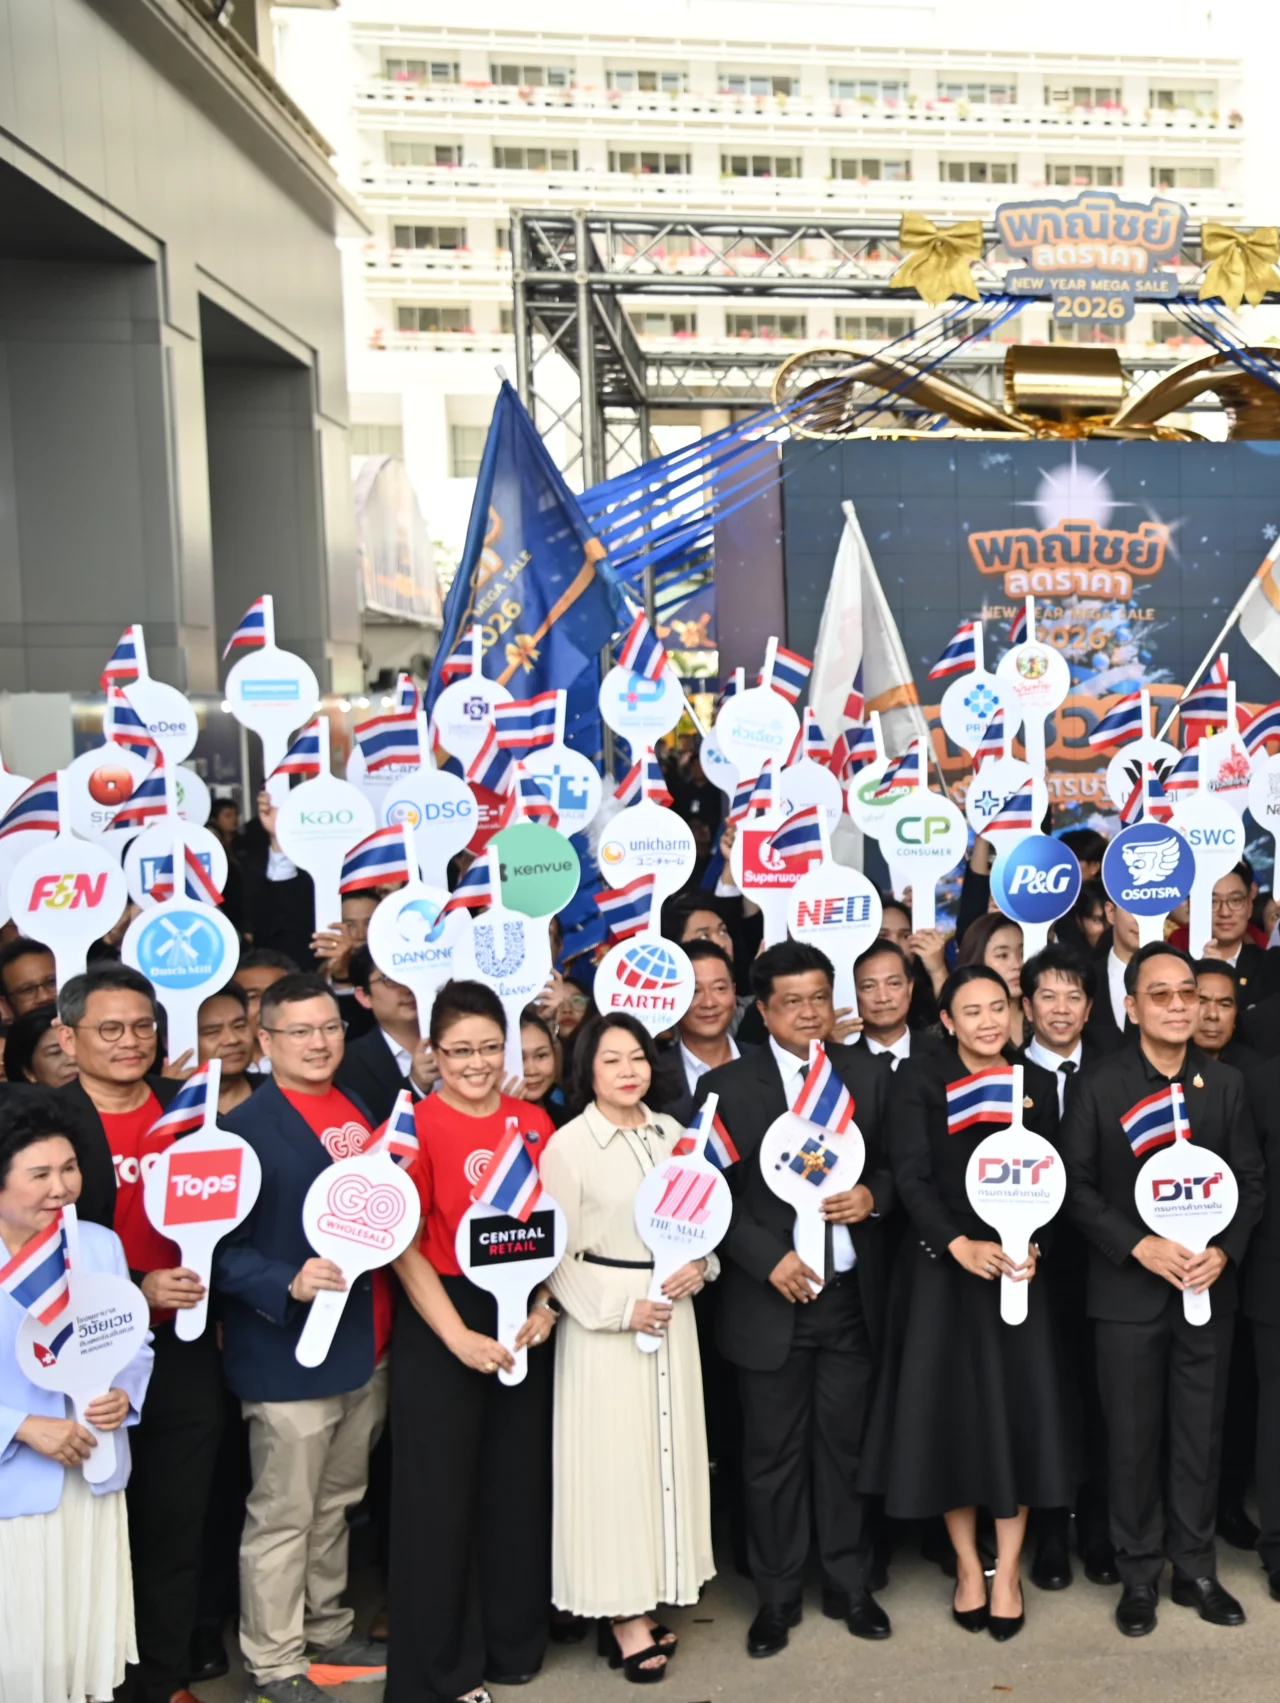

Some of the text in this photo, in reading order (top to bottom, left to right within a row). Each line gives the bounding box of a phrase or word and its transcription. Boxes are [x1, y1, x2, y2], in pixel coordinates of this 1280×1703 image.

[1004, 202, 1180, 250] พาณิชย์
[1033, 243, 1148, 271] ลดราคา
[1012, 277, 1169, 293] NEW YEAR MEGA SALE
[1056, 295, 1125, 319] 2026
[971, 521, 1166, 574] พาณิชย์
[503, 550, 532, 581] SALE
[1006, 570, 1131, 596] ลดราคา
[982, 605, 1016, 619] NEW
[1033, 607, 1063, 620] EAR
[480, 598, 522, 656] 026
[146, 721, 187, 732] eDee
[426, 800, 472, 820] DSG
[896, 816, 951, 844] CP
[1189, 829, 1237, 846] SWC
[630, 838, 690, 851] unicharm
[897, 848, 952, 857] CONSUMER
[1009, 863, 1073, 895] P&G
[28, 872, 108, 912] F&N
[1121, 887, 1181, 901] OSOTSPA
[797, 895, 872, 926] NEO
[151, 964, 213, 977] Dutch Mill
[611, 992, 676, 1010] EARTH
[171, 1174, 237, 1200] Tops
[327, 1174, 406, 1232] GO
[325, 1219, 389, 1244] WHOLESALE
[479, 1227, 545, 1246] CENTRAL
[650, 1217, 707, 1240] THE MALL
[489, 1241, 537, 1256] RETAIL
[79, 1311, 133, 1338] วิชัยเวช
